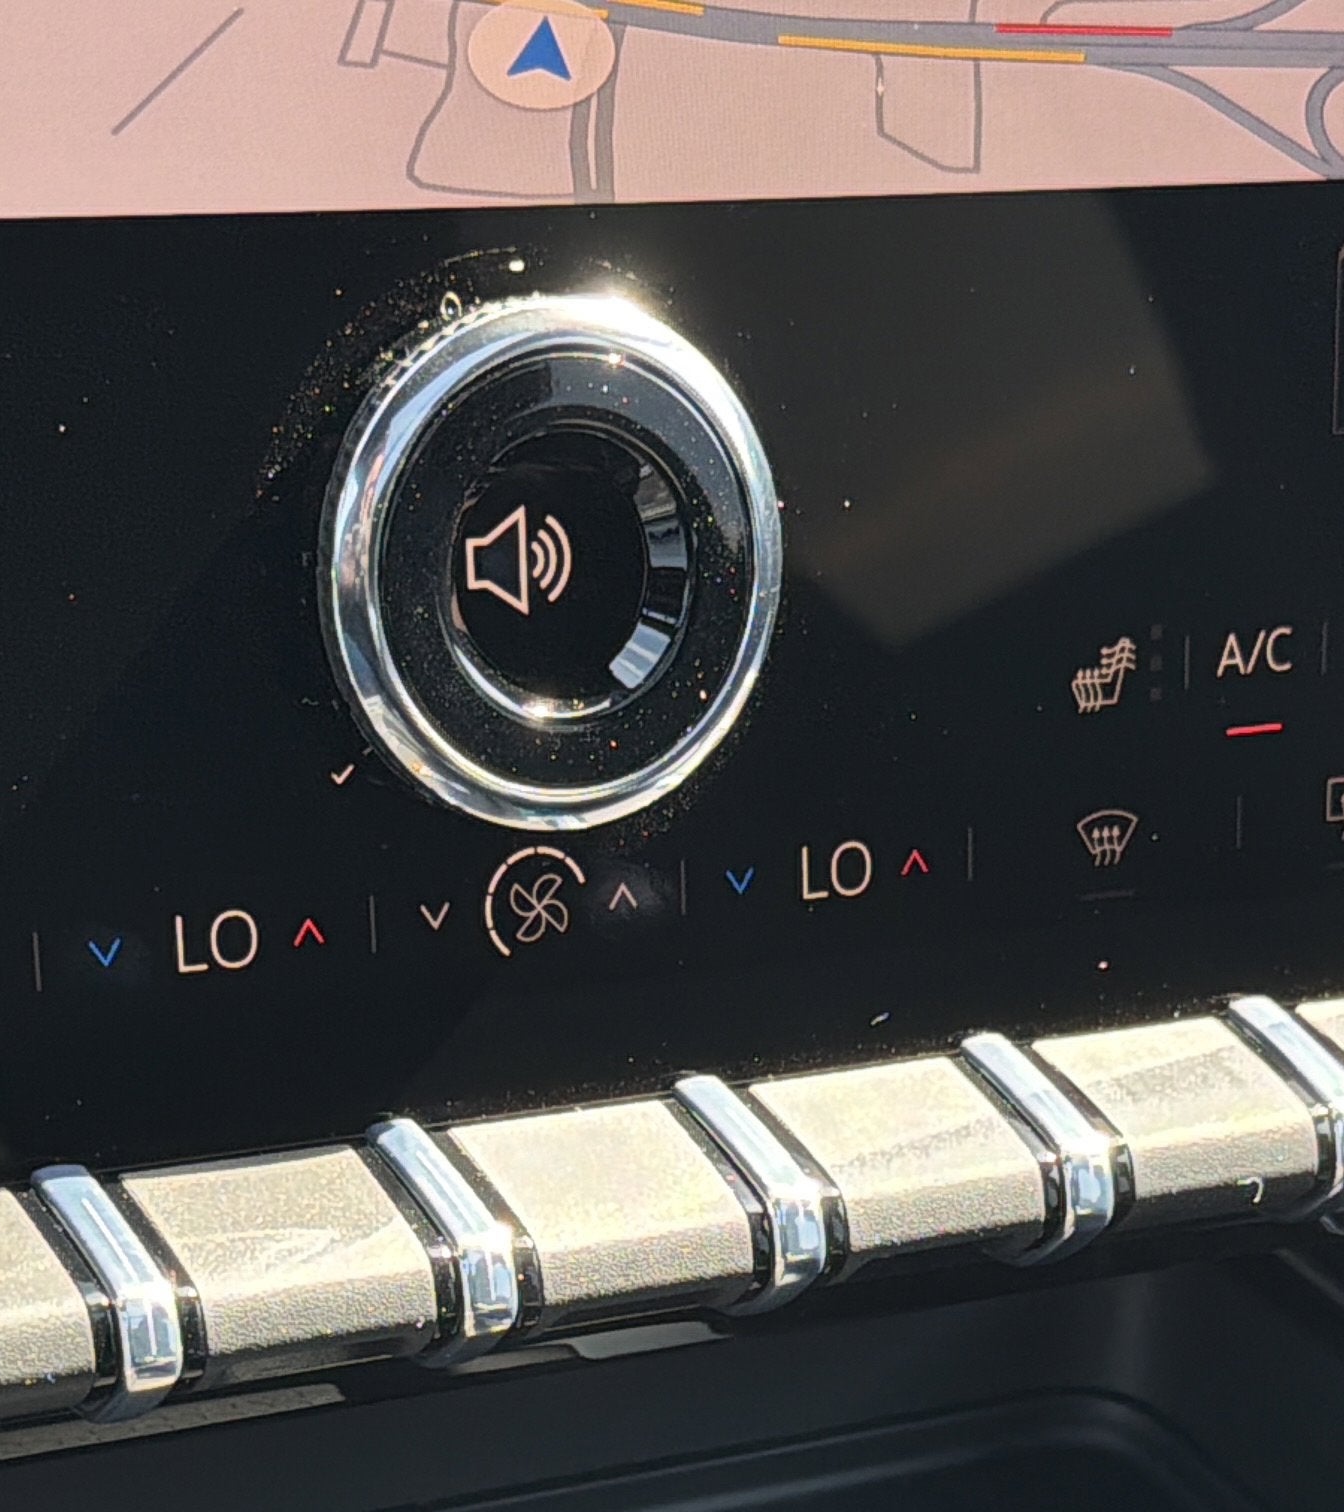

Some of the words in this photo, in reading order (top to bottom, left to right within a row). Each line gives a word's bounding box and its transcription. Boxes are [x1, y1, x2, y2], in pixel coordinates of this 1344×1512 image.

[1216, 626, 1293, 678] A/C
[801, 840, 872, 900] LO
[175, 908, 258, 973] LO
